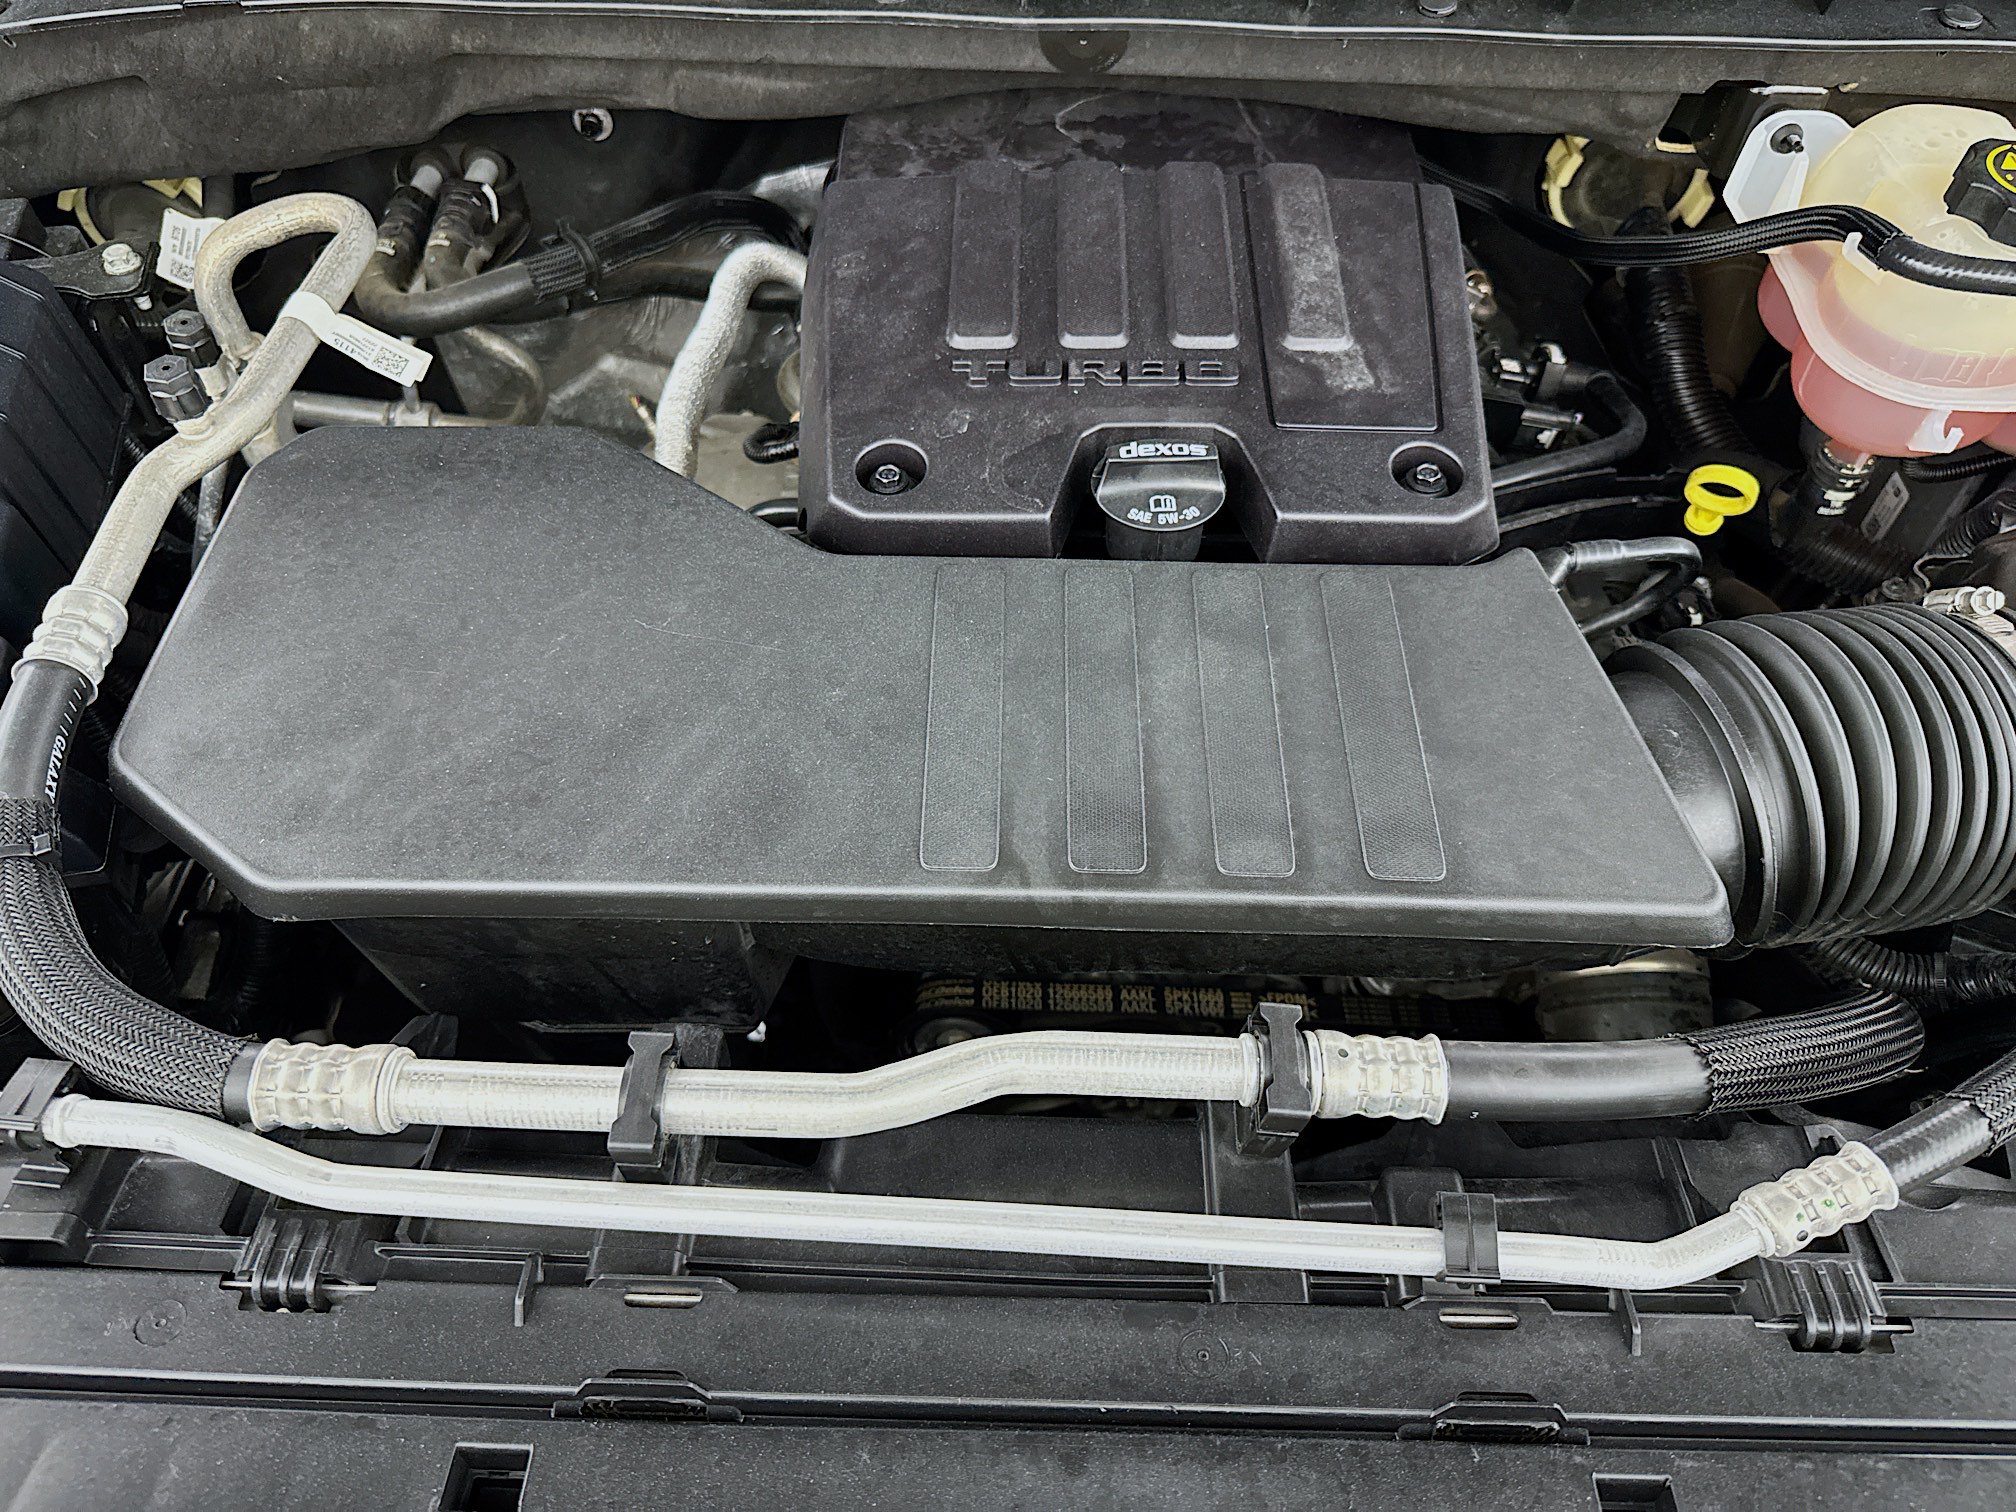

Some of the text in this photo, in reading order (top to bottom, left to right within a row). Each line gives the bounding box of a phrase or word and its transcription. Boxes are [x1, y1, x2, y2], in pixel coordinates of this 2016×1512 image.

[951, 358, 1240, 388] TURBO
[1119, 441, 1209, 459] dexos
[1127, 505, 1201, 525] SAE 5W-30
[44, 734, 67, 805] GALAXY
